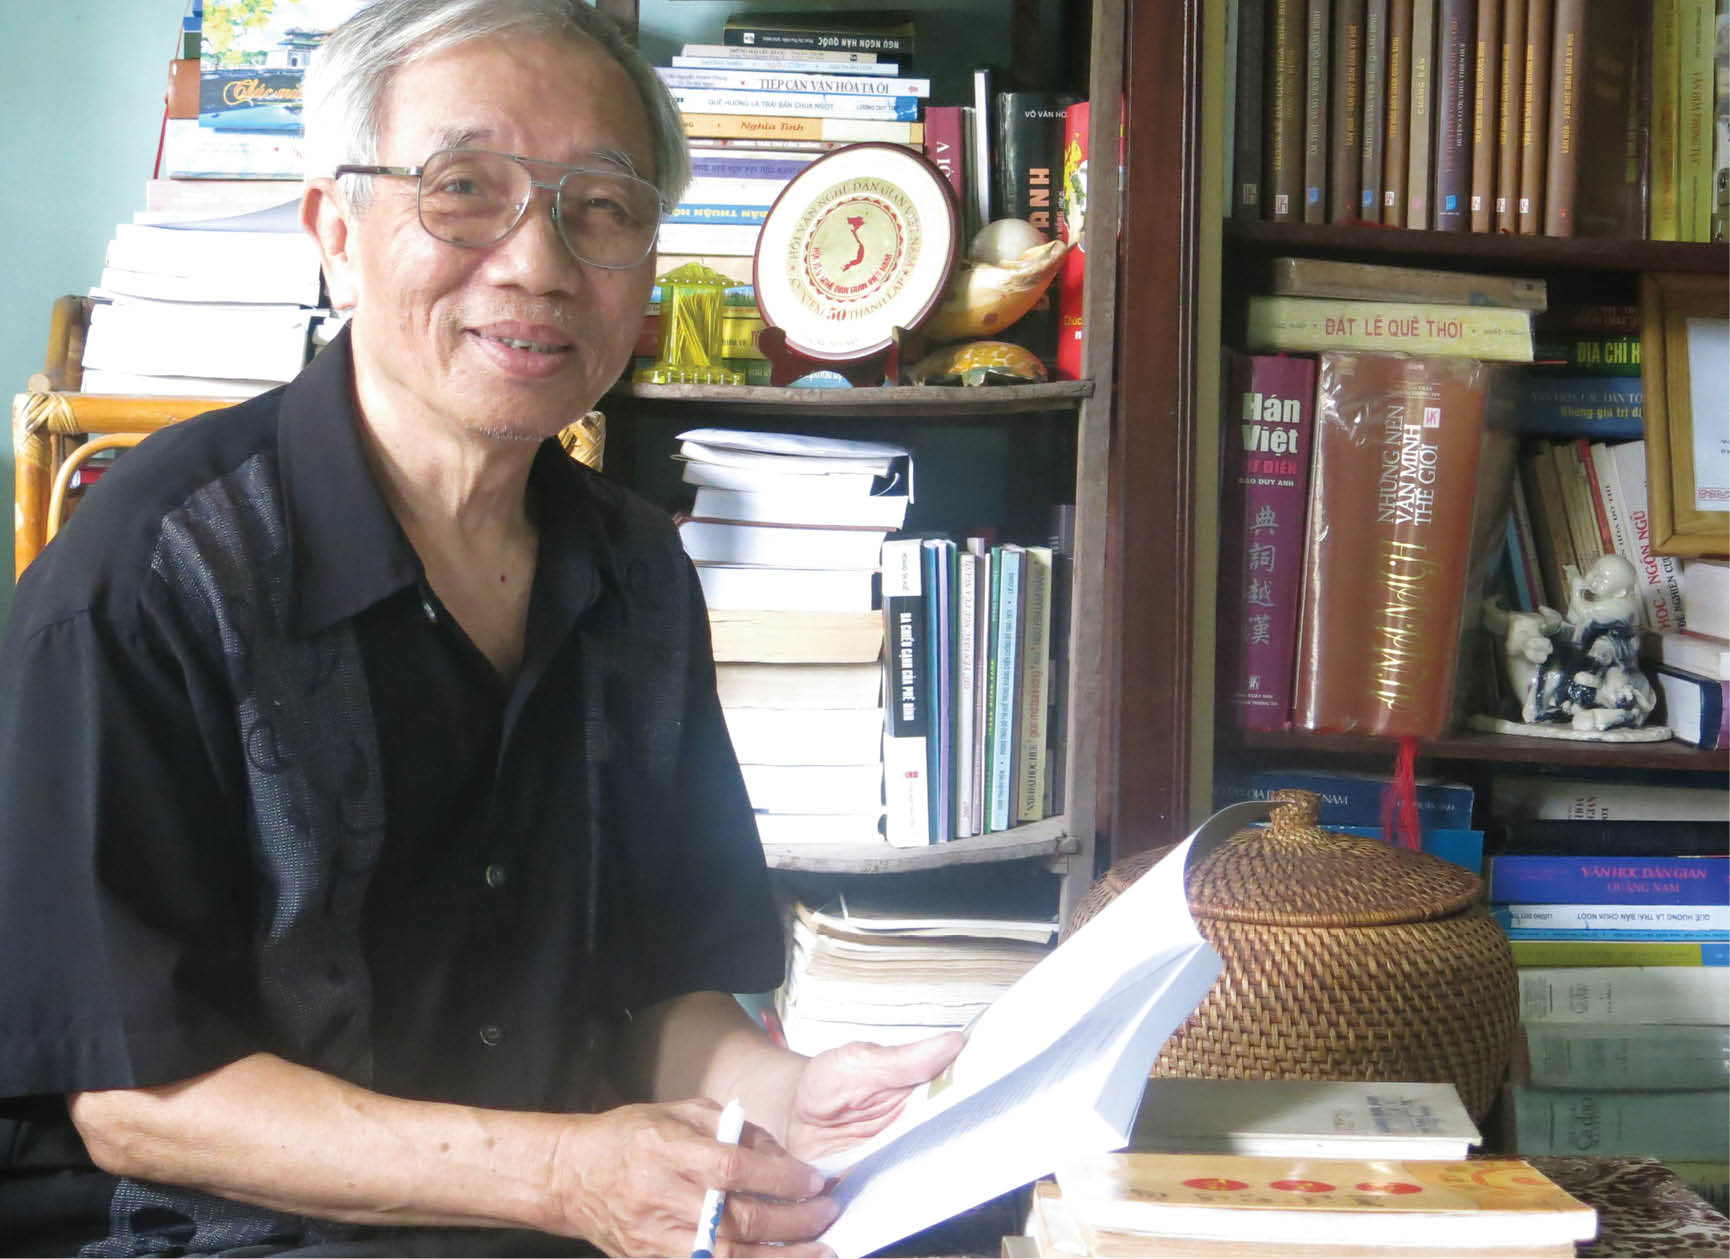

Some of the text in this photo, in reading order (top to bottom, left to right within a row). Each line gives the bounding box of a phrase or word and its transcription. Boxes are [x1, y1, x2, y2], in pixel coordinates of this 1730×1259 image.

[817, 36, 839, 48] QUỐC
[223, 79, 274, 107] Chúc
[760, 77, 785, 90] TIẾP
[810, 79, 833, 92] VĂN
[740, 120, 804, 132] Nghĩa Tình
[1037, 110, 1054, 118] VĂN
[826, 306, 848, 321] 50
[1325, 314, 1355, 336] ĐẤT
[1388, 316, 1420, 339] QUÊ
[1425, 316, 1463, 339] THÓI
[1577, 341, 1600, 368] ĐỊA
[1604, 336, 1627, 364] CHÍ
[1242, 392, 1301, 424] Hán
[1241, 424, 1298, 457] Việt
[1376, 404, 1405, 523] NHỮNG NỀN
[1394, 423, 1421, 525] VĂN MINH
[1258, 477, 1275, 486] DUY
[1278, 479, 1294, 488] ANH
[1412, 443, 1438, 526] THẾ GIỚI
[1629, 510, 1671, 631] HỌC NGÔN NGỮ
[1665, 575, 1683, 612] NGHIÊN
[1322, 793, 1349, 806] NAM
[1673, 866, 1707, 881] GIAN
